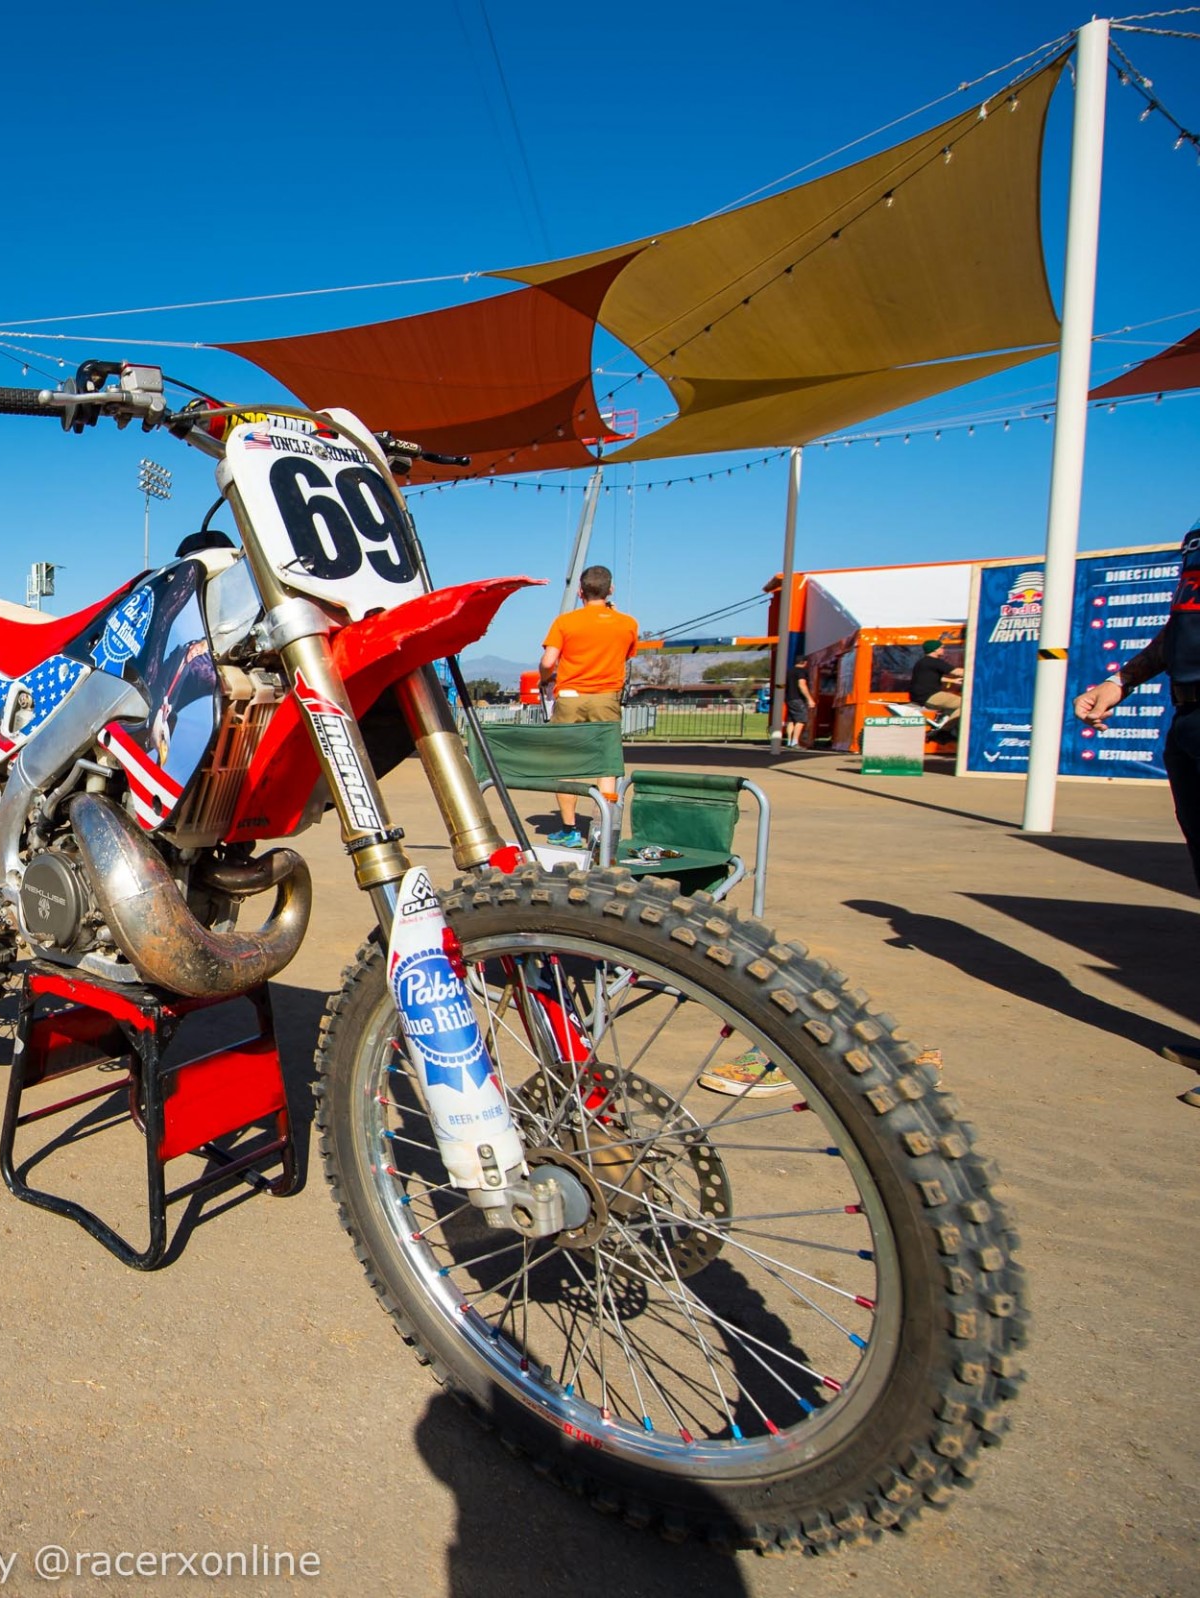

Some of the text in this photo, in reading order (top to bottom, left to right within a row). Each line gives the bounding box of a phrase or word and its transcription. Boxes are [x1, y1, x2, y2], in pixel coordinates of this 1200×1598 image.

[269, 434, 313, 456] UNCLE
[269, 456, 419, 584] 69
[1105, 565, 1180, 583] DIRECTIONS
[1108, 591, 1174, 606] GRANDSTANDS
[999, 617, 1041, 630] STRAIG
[1106, 615, 1171, 628] START ACCESS
[1139, 683, 1162, 694] ROW
[1139, 706, 1165, 716] SHOP
[875, 717, 926, 725] WE RECYCLE
[312, 713, 331, 758] RACING
[1098, 751, 1154, 762] RESTROOMS
[319, 714, 381, 830] MERGE
[404, 967, 464, 1008] Pabst
[448, 1113, 476, 1126] BEER
